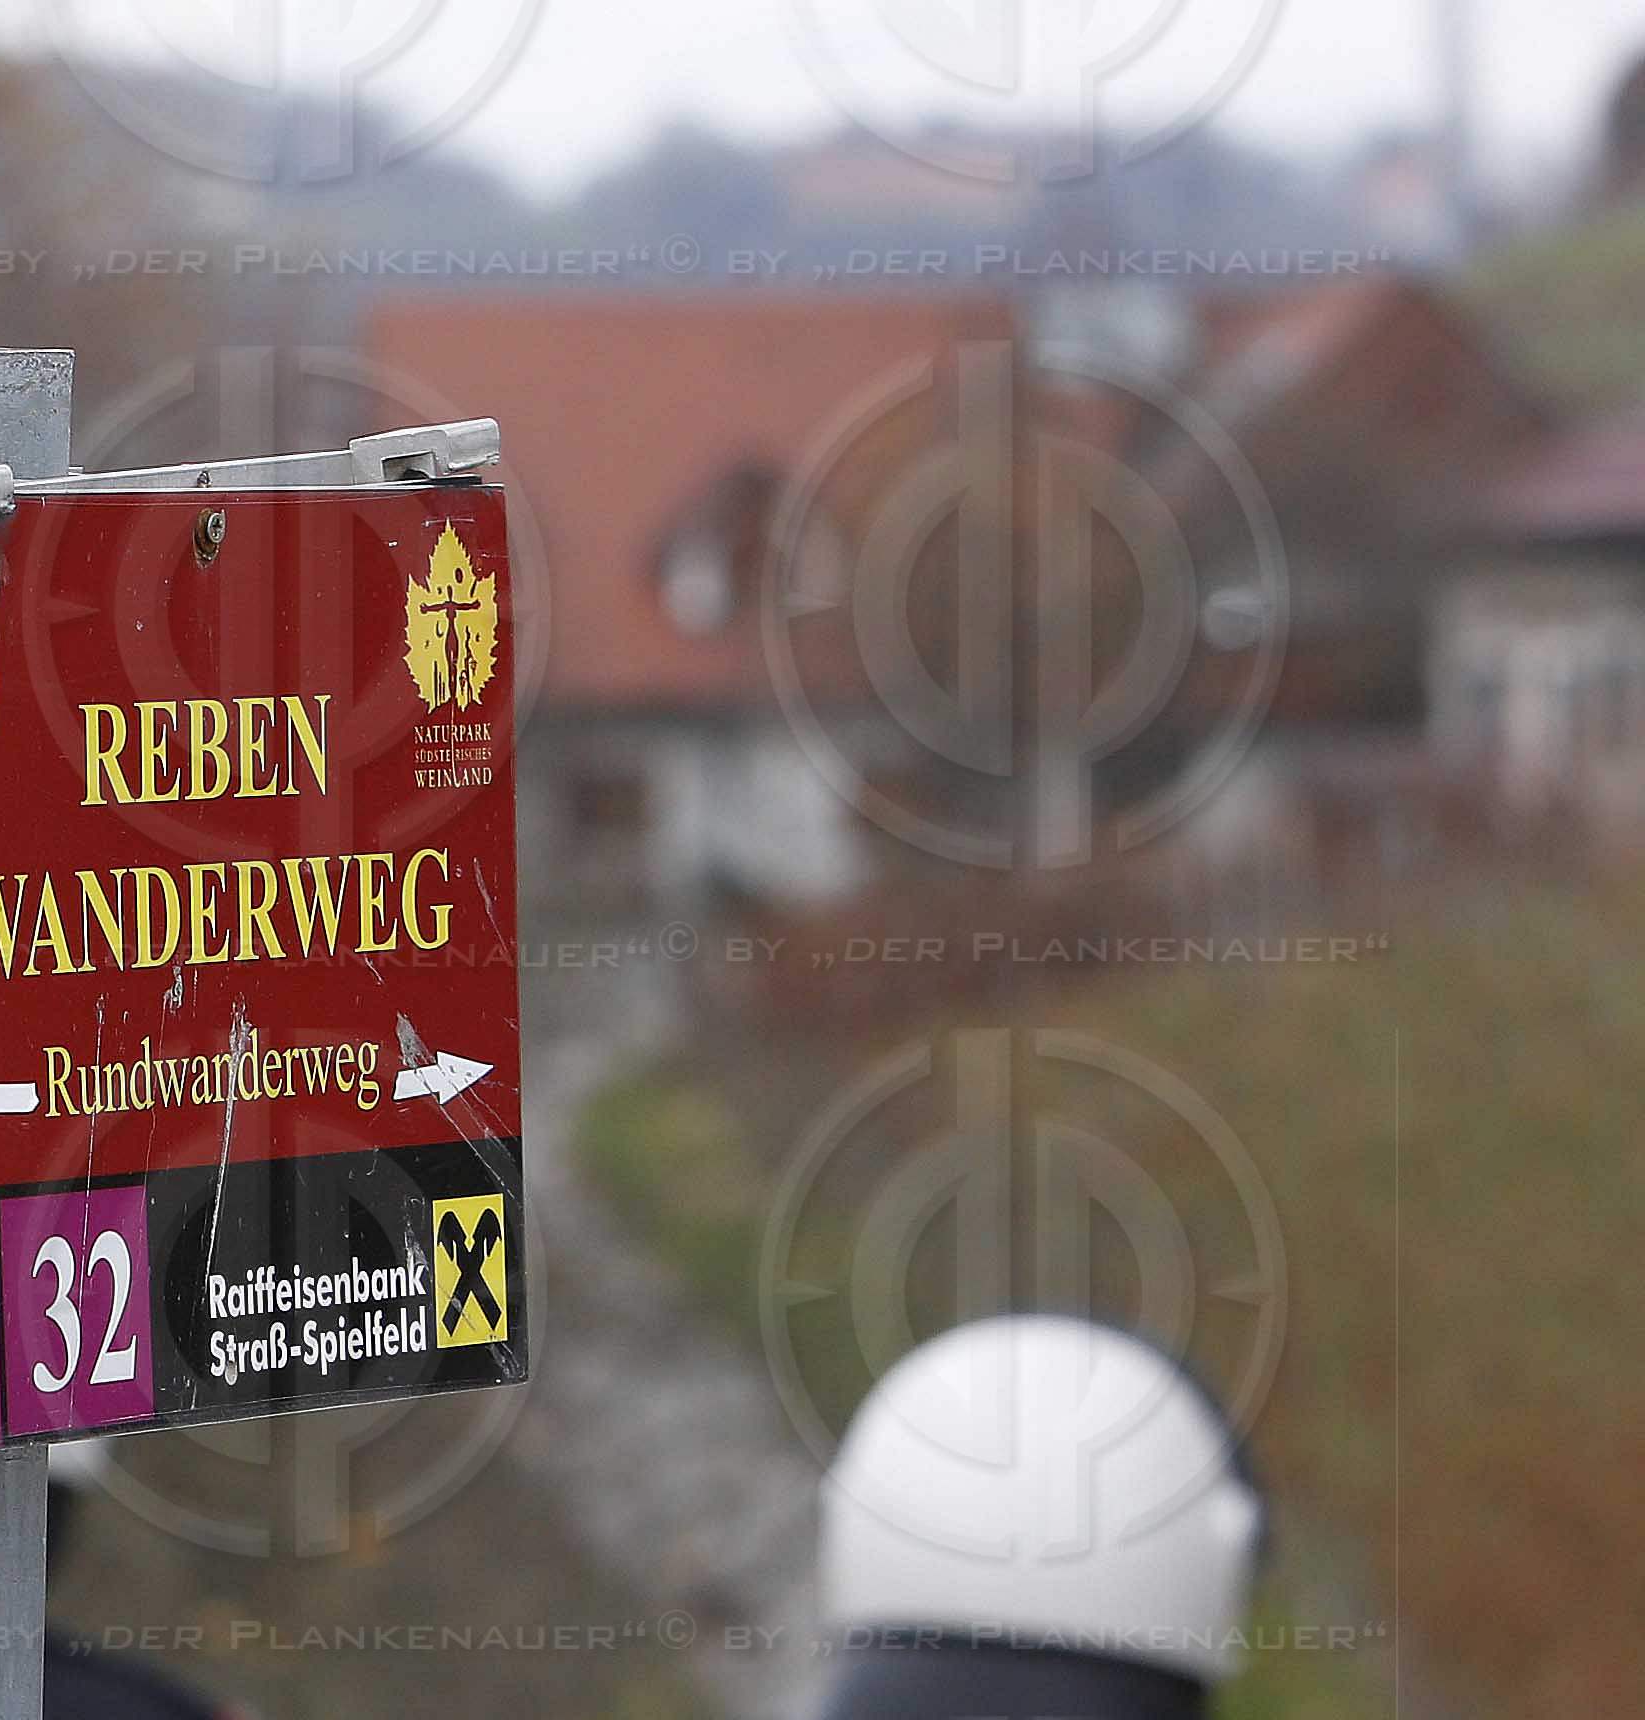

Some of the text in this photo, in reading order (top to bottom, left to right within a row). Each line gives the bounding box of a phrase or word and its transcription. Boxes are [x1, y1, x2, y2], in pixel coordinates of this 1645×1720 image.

[78, 695, 331, 806] REBEN
[414, 723, 492, 744] NATURPARK
[414, 767, 493, 788] WEINLAND
[42, 1028, 381, 1119] Rundwanderweg
[30, 1229, 138, 1394] 32
[208, 1256, 427, 1320] Raiffeisenbank
[209, 1307, 428, 1379] Straß-Spielfeld
